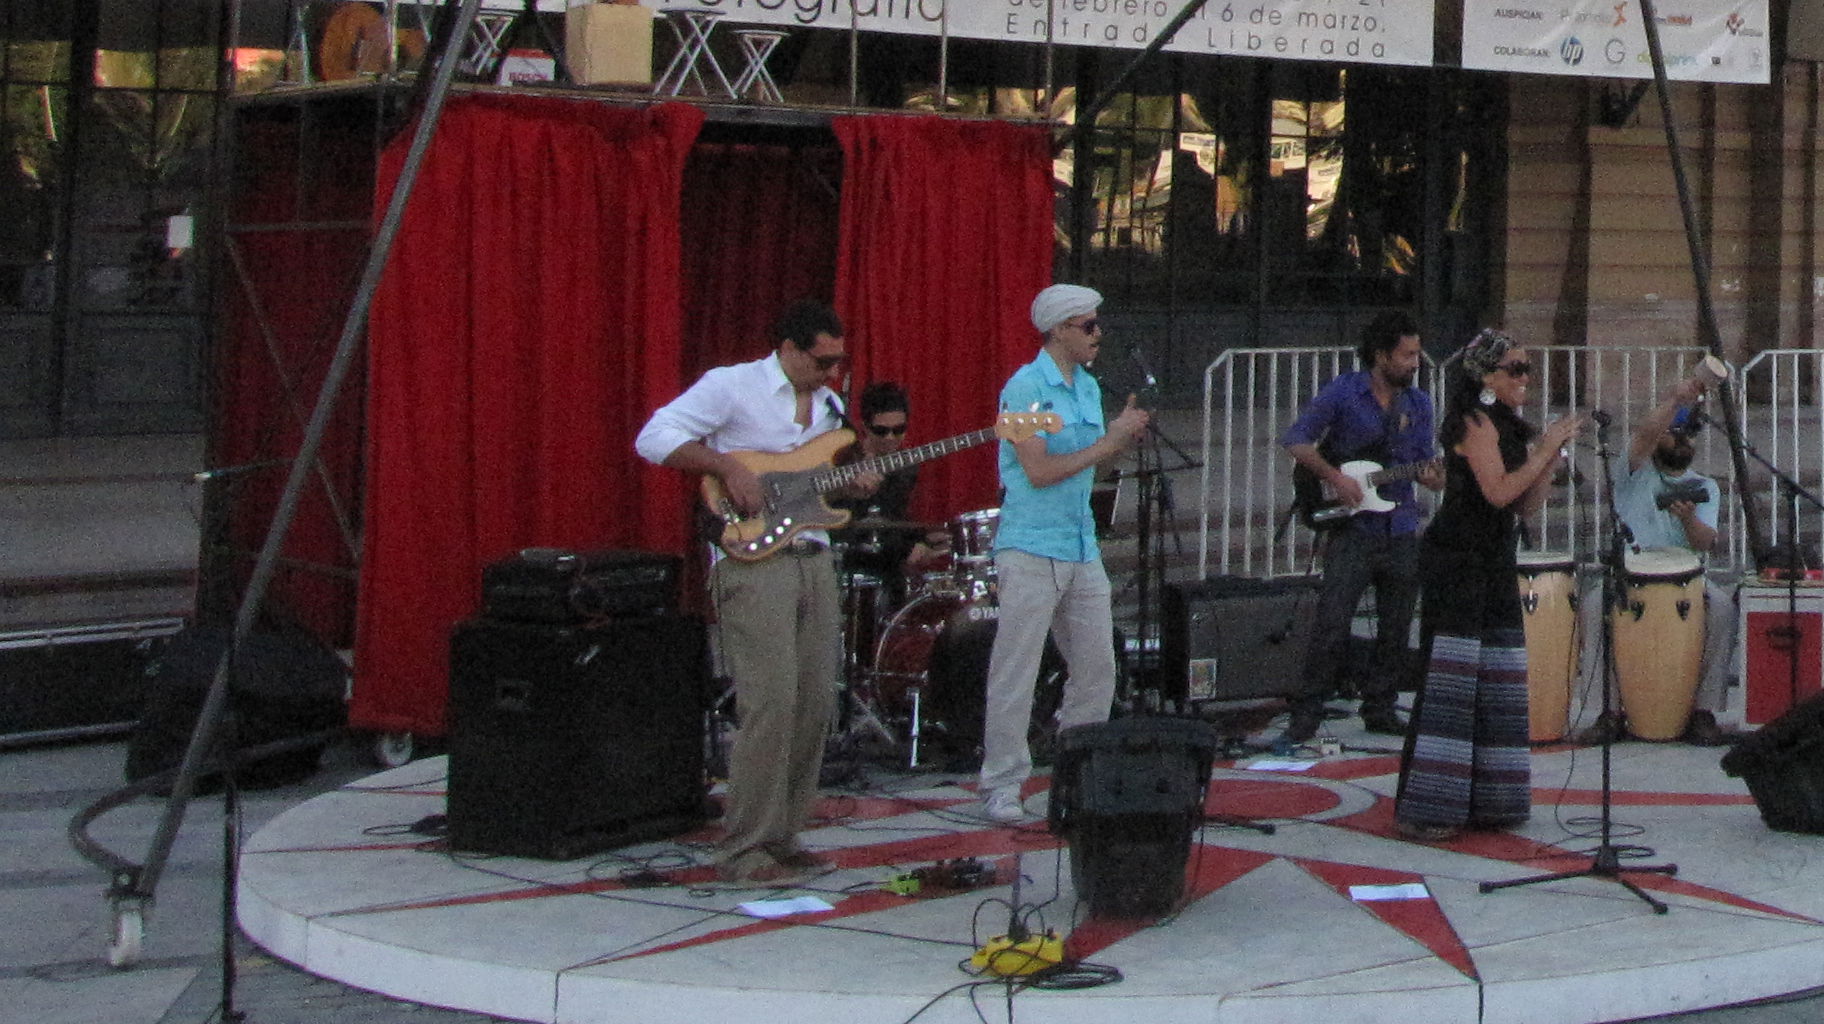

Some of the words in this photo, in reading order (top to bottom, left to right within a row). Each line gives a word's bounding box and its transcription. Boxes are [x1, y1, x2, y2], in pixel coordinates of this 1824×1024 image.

[1221, 2, 1234, 23] 6
[1250, 5, 1283, 26] de
[1297, 9, 1387, 34] marzo.
[1207, 26, 1386, 59] Liberada
